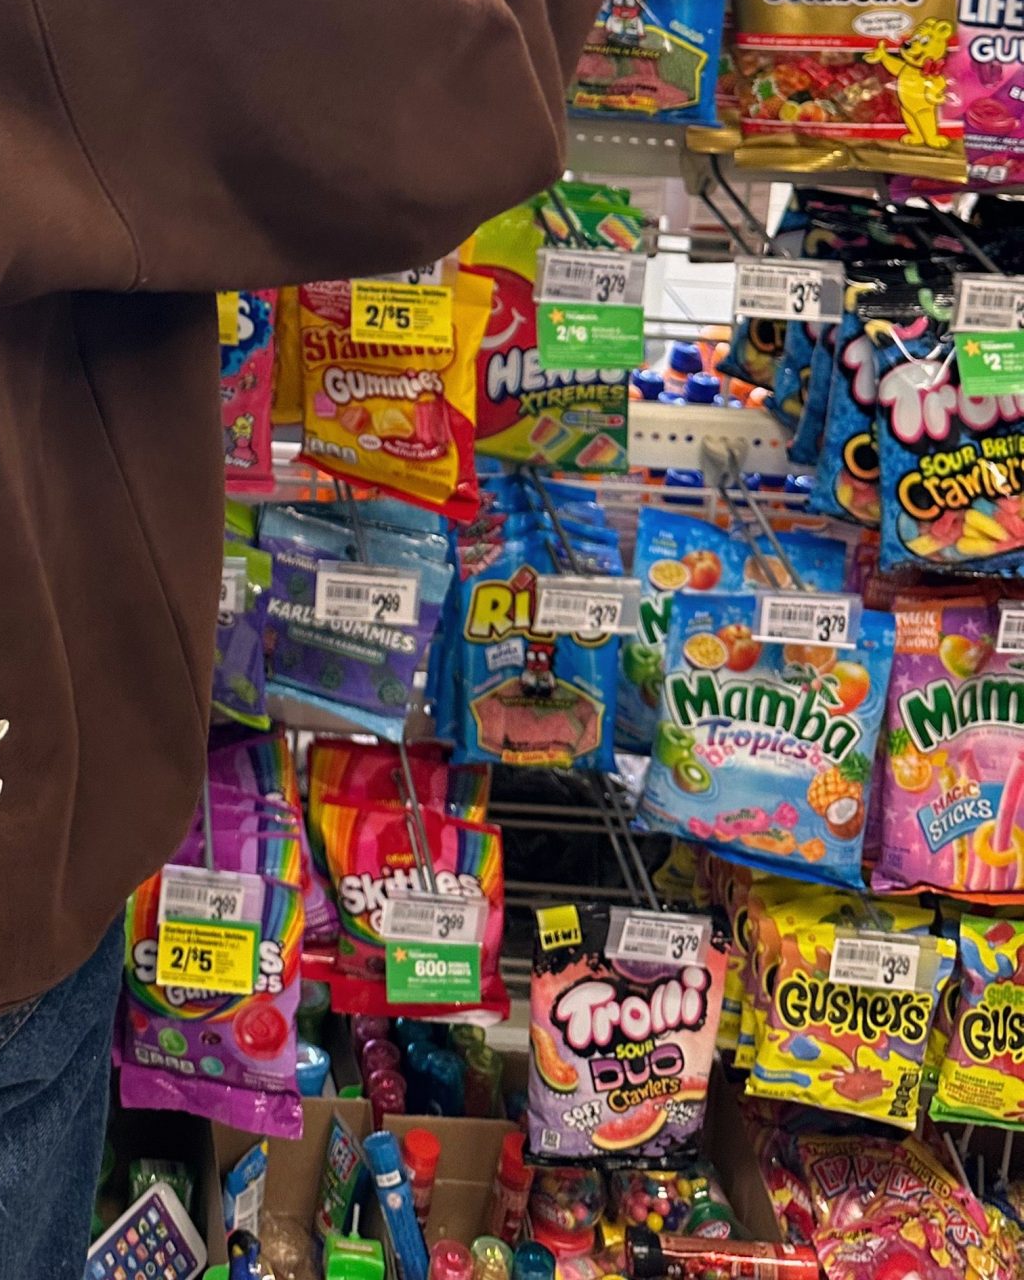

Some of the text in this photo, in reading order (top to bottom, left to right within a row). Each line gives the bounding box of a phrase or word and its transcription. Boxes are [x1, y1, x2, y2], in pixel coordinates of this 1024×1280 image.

[366, 305, 410, 329] 2/$5
[982, 351, 1002, 371] $2
[519, 384, 625, 414] XTREMES
[920, 444, 976, 477] SOUR
[898, 457, 1024, 520] Crawler
[331, 619, 417, 652] GUMMIES
[670, 673, 861, 761] Mamba
[900, 677, 1024, 753] Mam
[696, 719, 811, 760] Tropics
[932, 781, 980, 816] MAGIC
[928, 798, 993, 843] STICKS
[171, 946, 213, 973] 2/$5
[414, 959, 447, 977] 600
[556, 966, 708, 1049] Trolli
[778, 975, 929, 1041] Gushers
[589, 1043, 684, 1092] DUO
[615, 1040, 655, 1061] SOUR
[607, 1075, 681, 1112] Crawlers
[563, 1099, 602, 1127] SOFT
